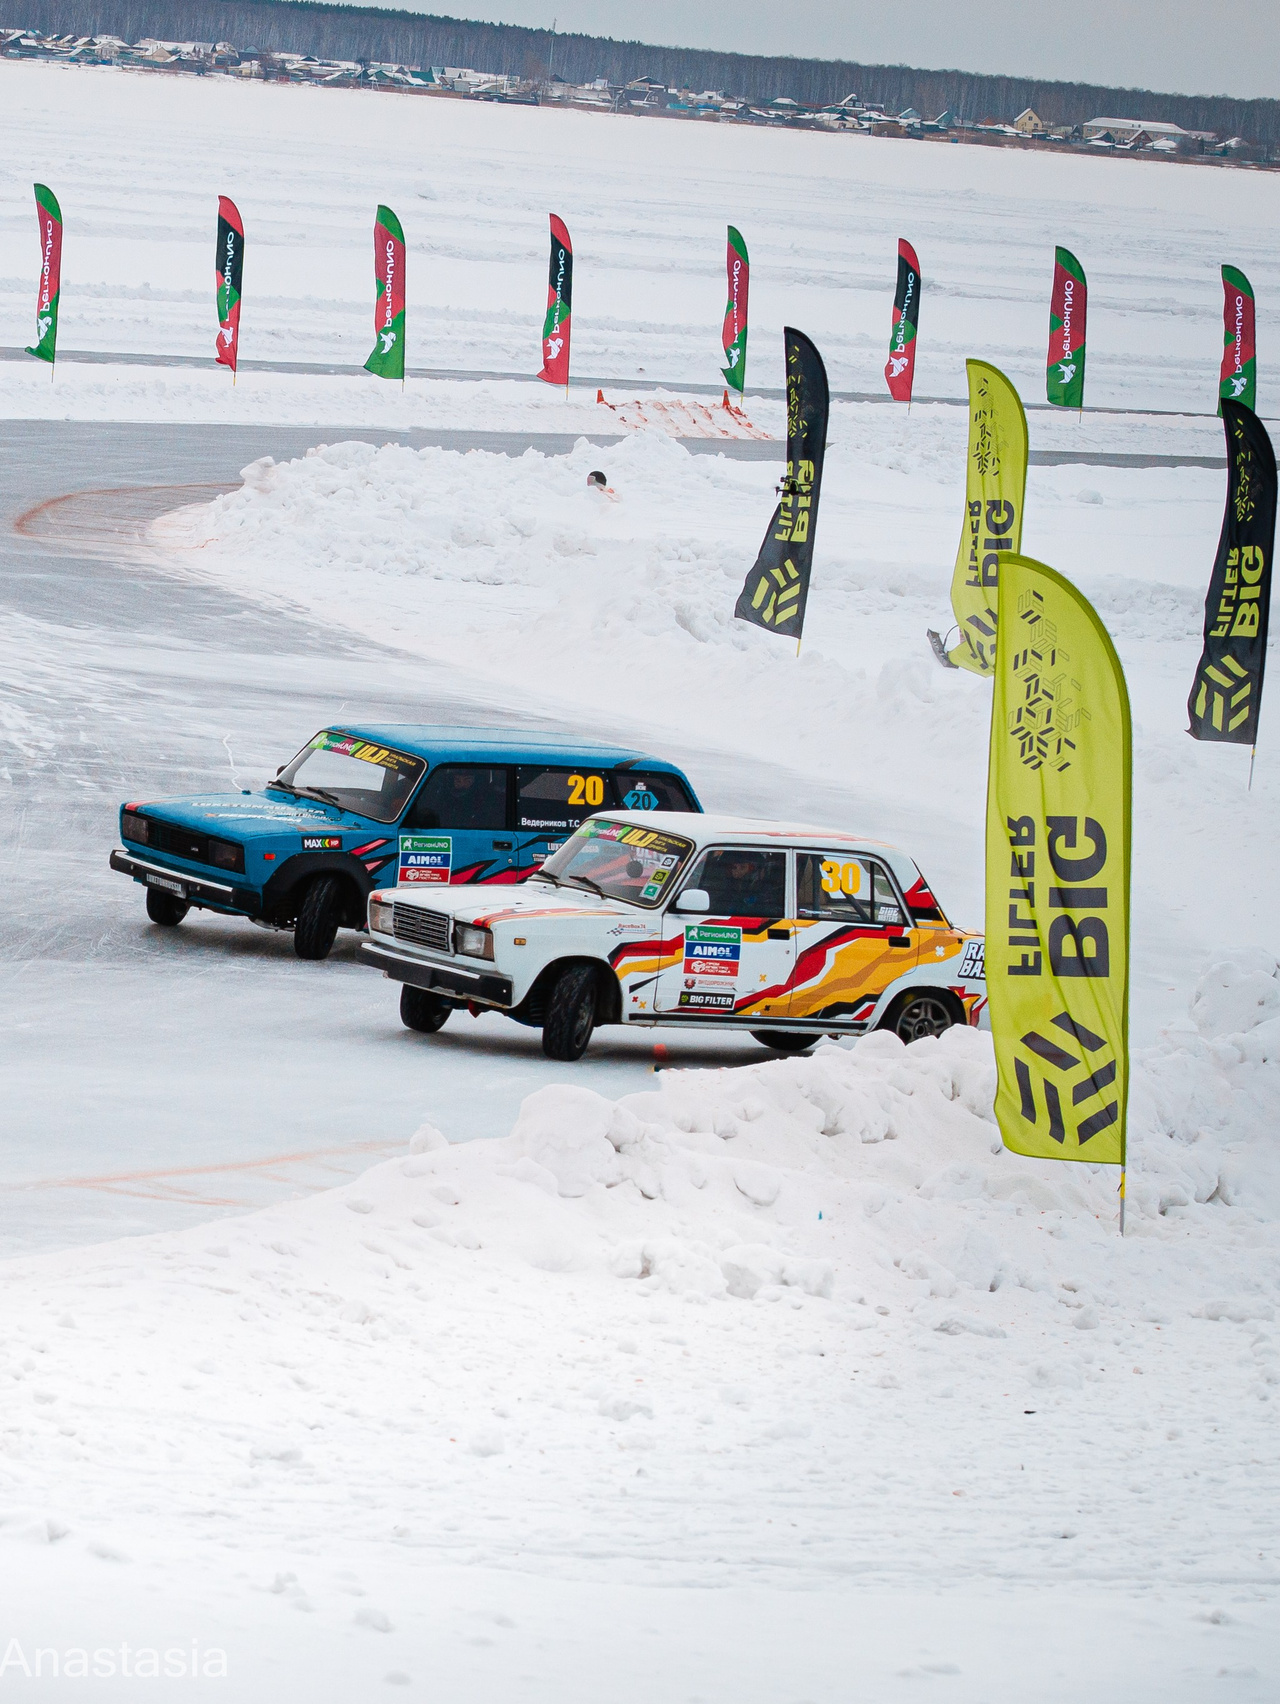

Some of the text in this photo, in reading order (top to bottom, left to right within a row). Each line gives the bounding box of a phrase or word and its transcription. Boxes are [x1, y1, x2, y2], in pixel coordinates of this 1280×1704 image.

[354, 744, 390, 764] ULD
[567, 774, 604, 806] 20
[630, 792, 652, 811] 20
[521, 817, 567, 828] Ведерников
[304, 839, 322, 848] MAX
[621, 828, 659, 848] ULD
[821, 860, 861, 895] 30
[689, 995, 733, 1005] BIG FILTER
